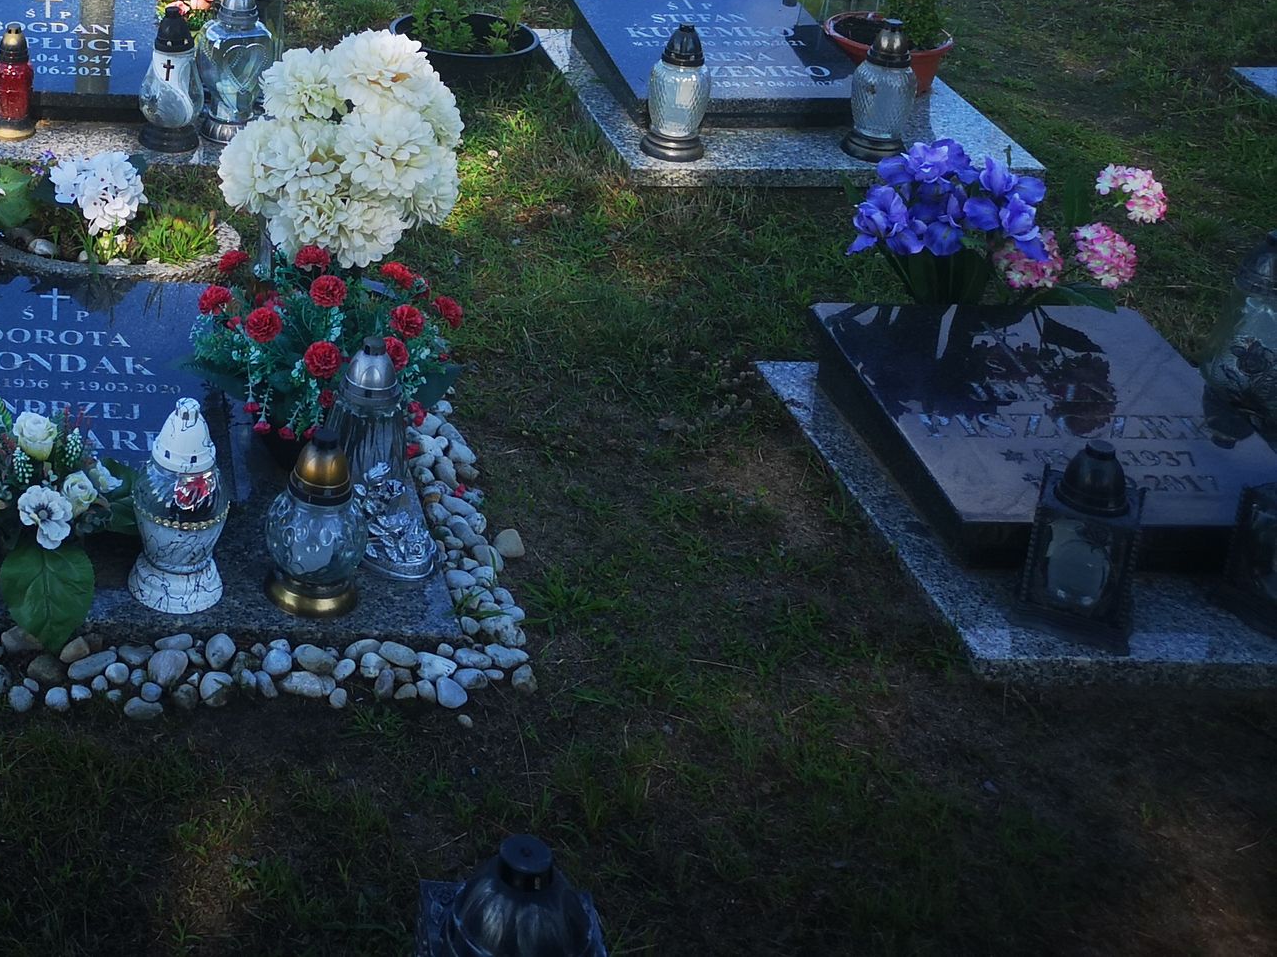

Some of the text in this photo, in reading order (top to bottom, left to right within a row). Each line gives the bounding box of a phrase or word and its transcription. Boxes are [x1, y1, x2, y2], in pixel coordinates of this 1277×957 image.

[25, 7, 72, 19] Ś P
[650, 13, 749, 24] STEFAN
[626, 26, 795, 39] KUEMKO
[705, 51, 776, 62] RENA
[707, 64, 832, 78] ZEMKO
[21, 305, 90, 322] Ś P
